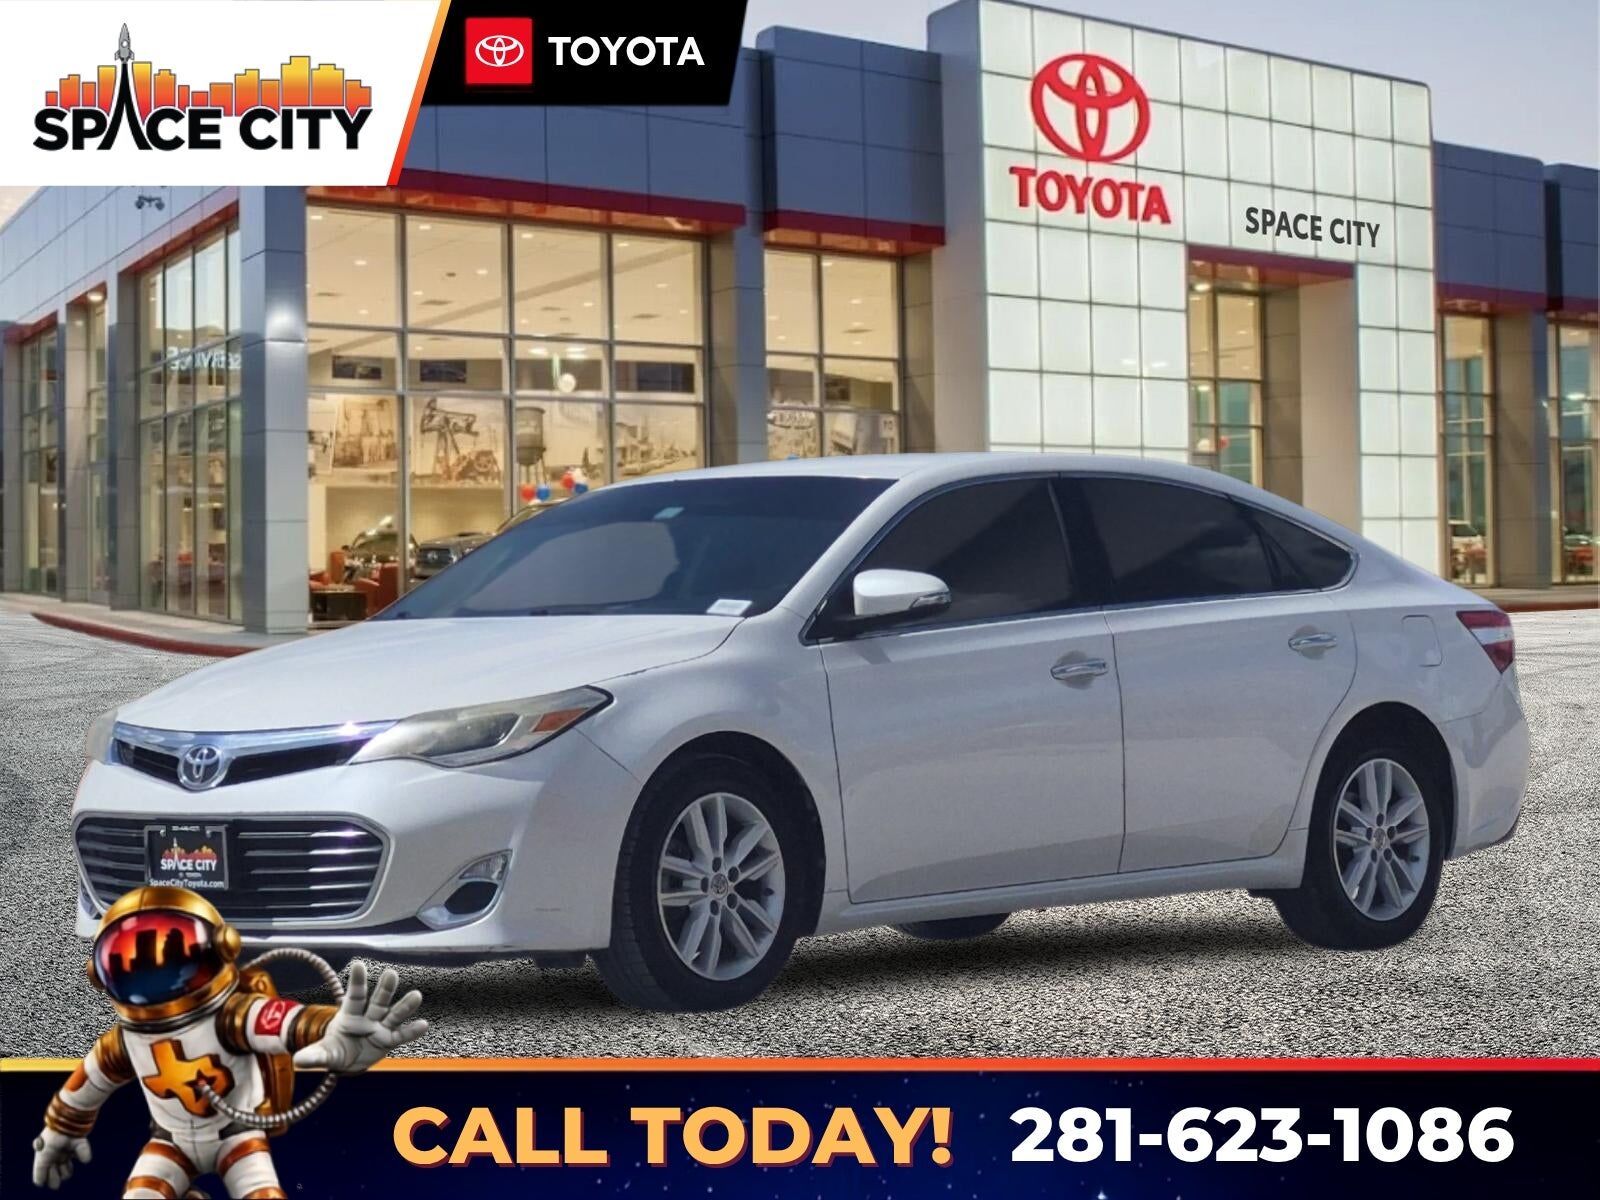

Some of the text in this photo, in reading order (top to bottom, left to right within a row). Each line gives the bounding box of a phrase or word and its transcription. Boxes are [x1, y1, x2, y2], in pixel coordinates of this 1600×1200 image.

[1010, 165, 1171, 224] TOYOTA
[1245, 206, 1381, 248] SPACE CITY
[160, 858, 217, 871] SPACE CITY
